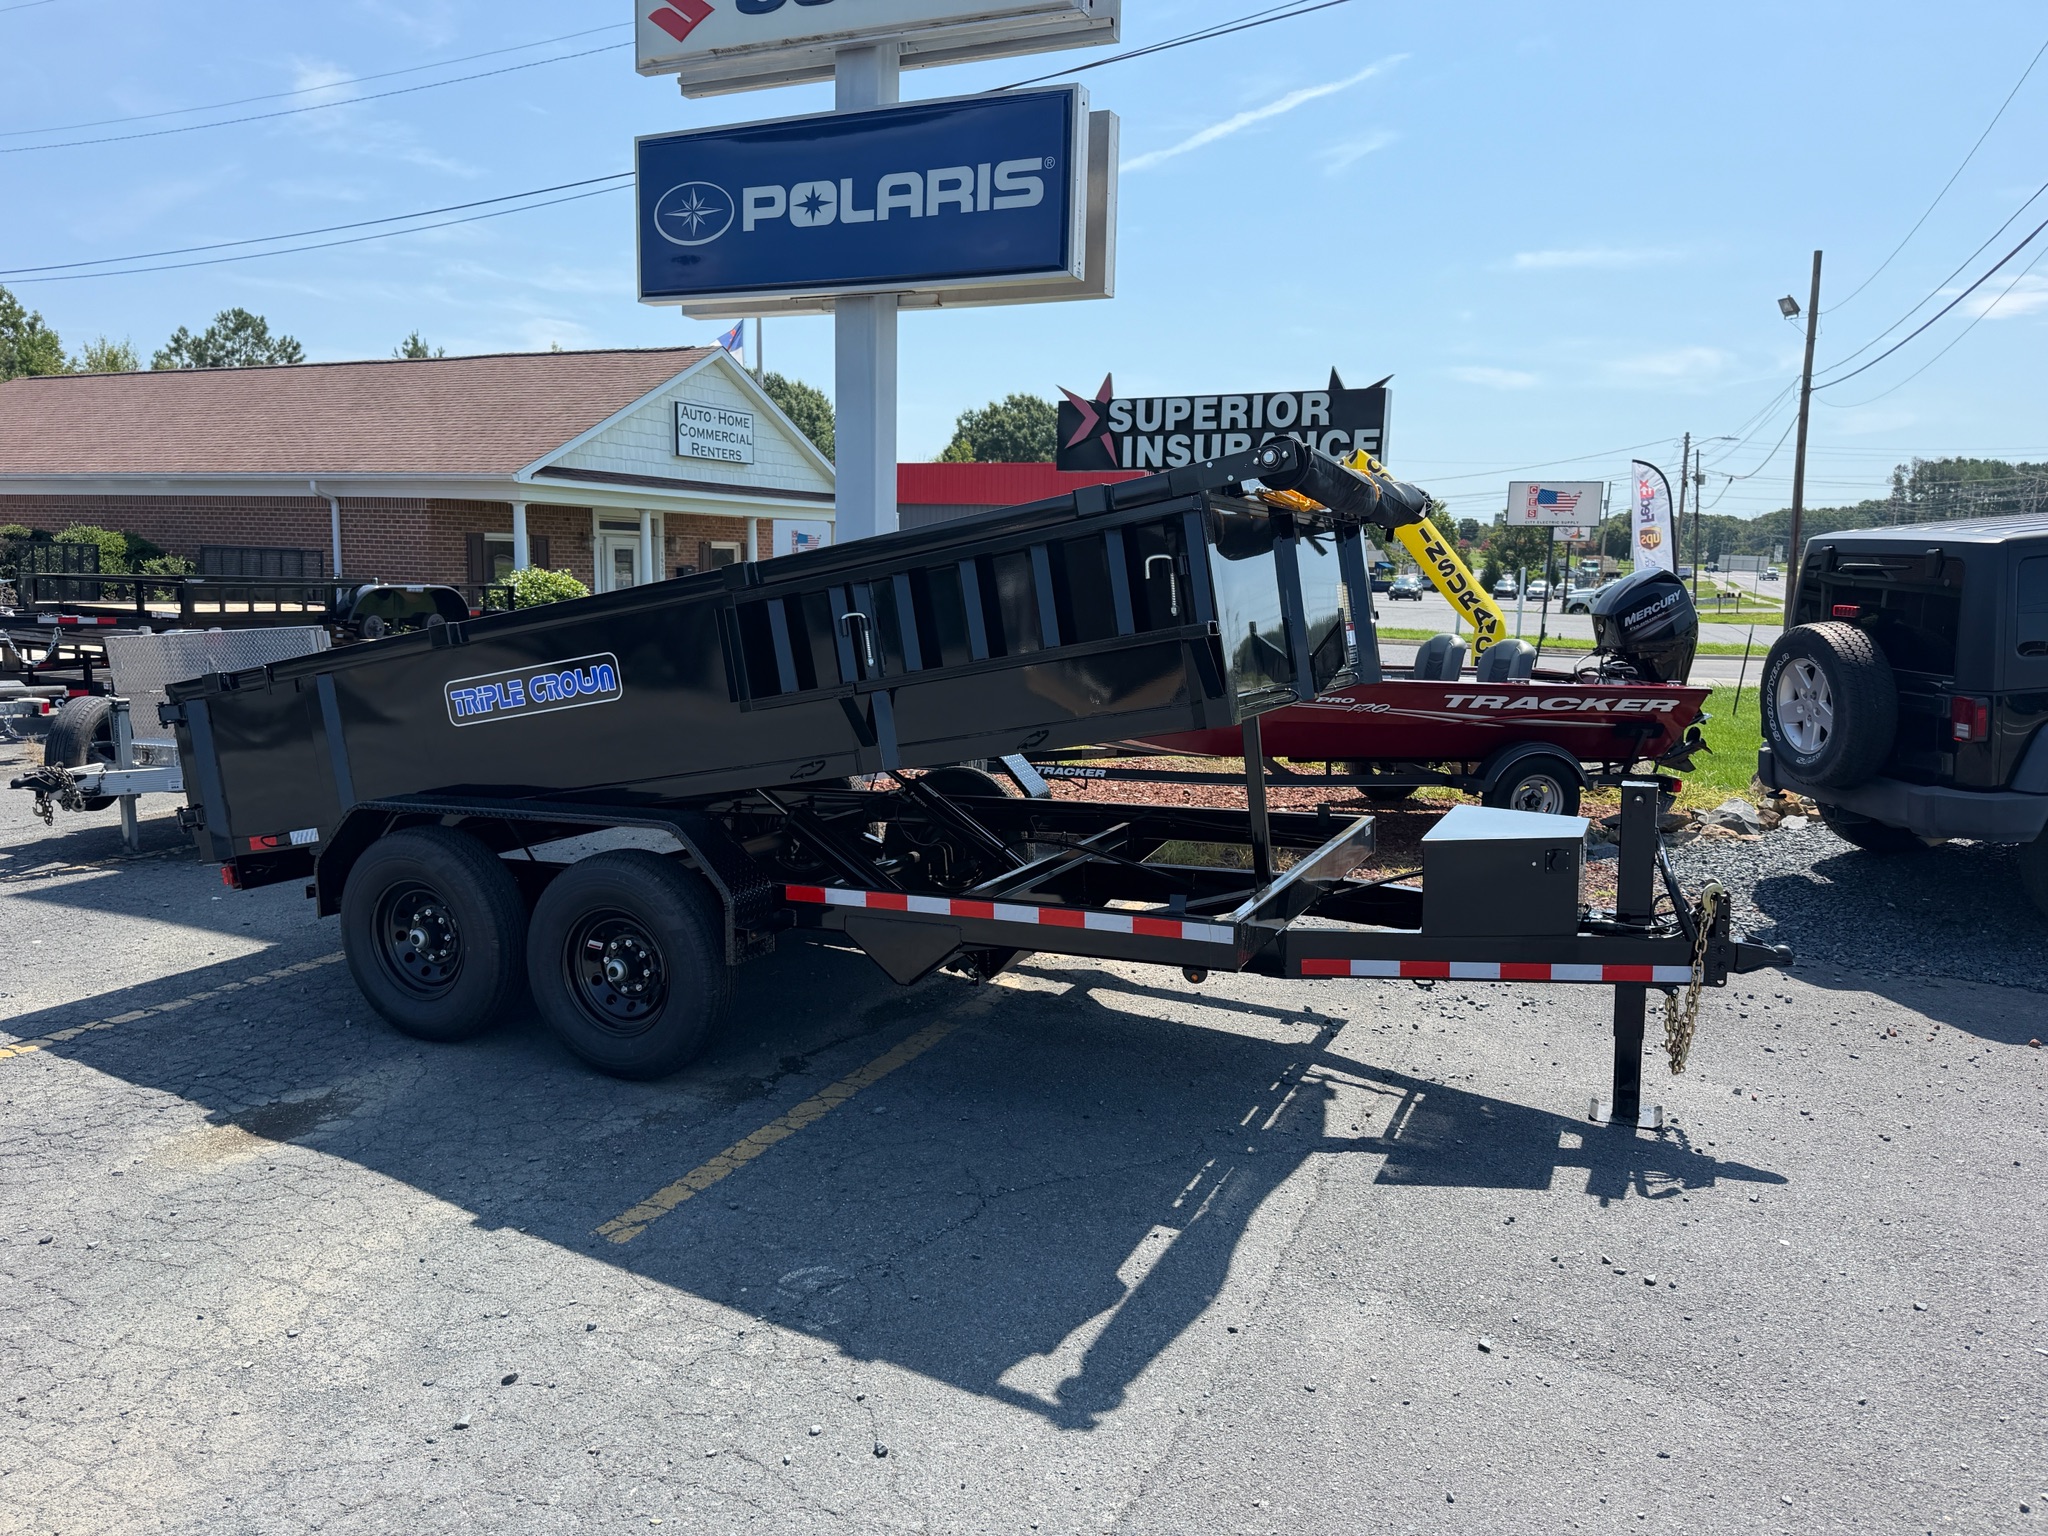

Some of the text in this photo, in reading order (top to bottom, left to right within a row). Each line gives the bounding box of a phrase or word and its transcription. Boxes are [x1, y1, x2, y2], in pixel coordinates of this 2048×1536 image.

[742, 156, 1045, 232] POLARIS
[681, 405, 750, 429] AUTO HOME
[1108, 392, 1331, 433] SUPERIOR
[680, 422, 752, 446] COMMERCIAL
[691, 442, 742, 461] RENTERS
[1526, 485, 1540, 518] CES
[1624, 589, 1682, 628] MERCURY
[450, 663, 617, 717] TRIPLE CROWN
[1315, 696, 1356, 704] PRO
[1443, 694, 1681, 713] TRACKER
[1766, 652, 1791, 742] GOODYEAR
[1035, 766, 1107, 778] TRACKER
